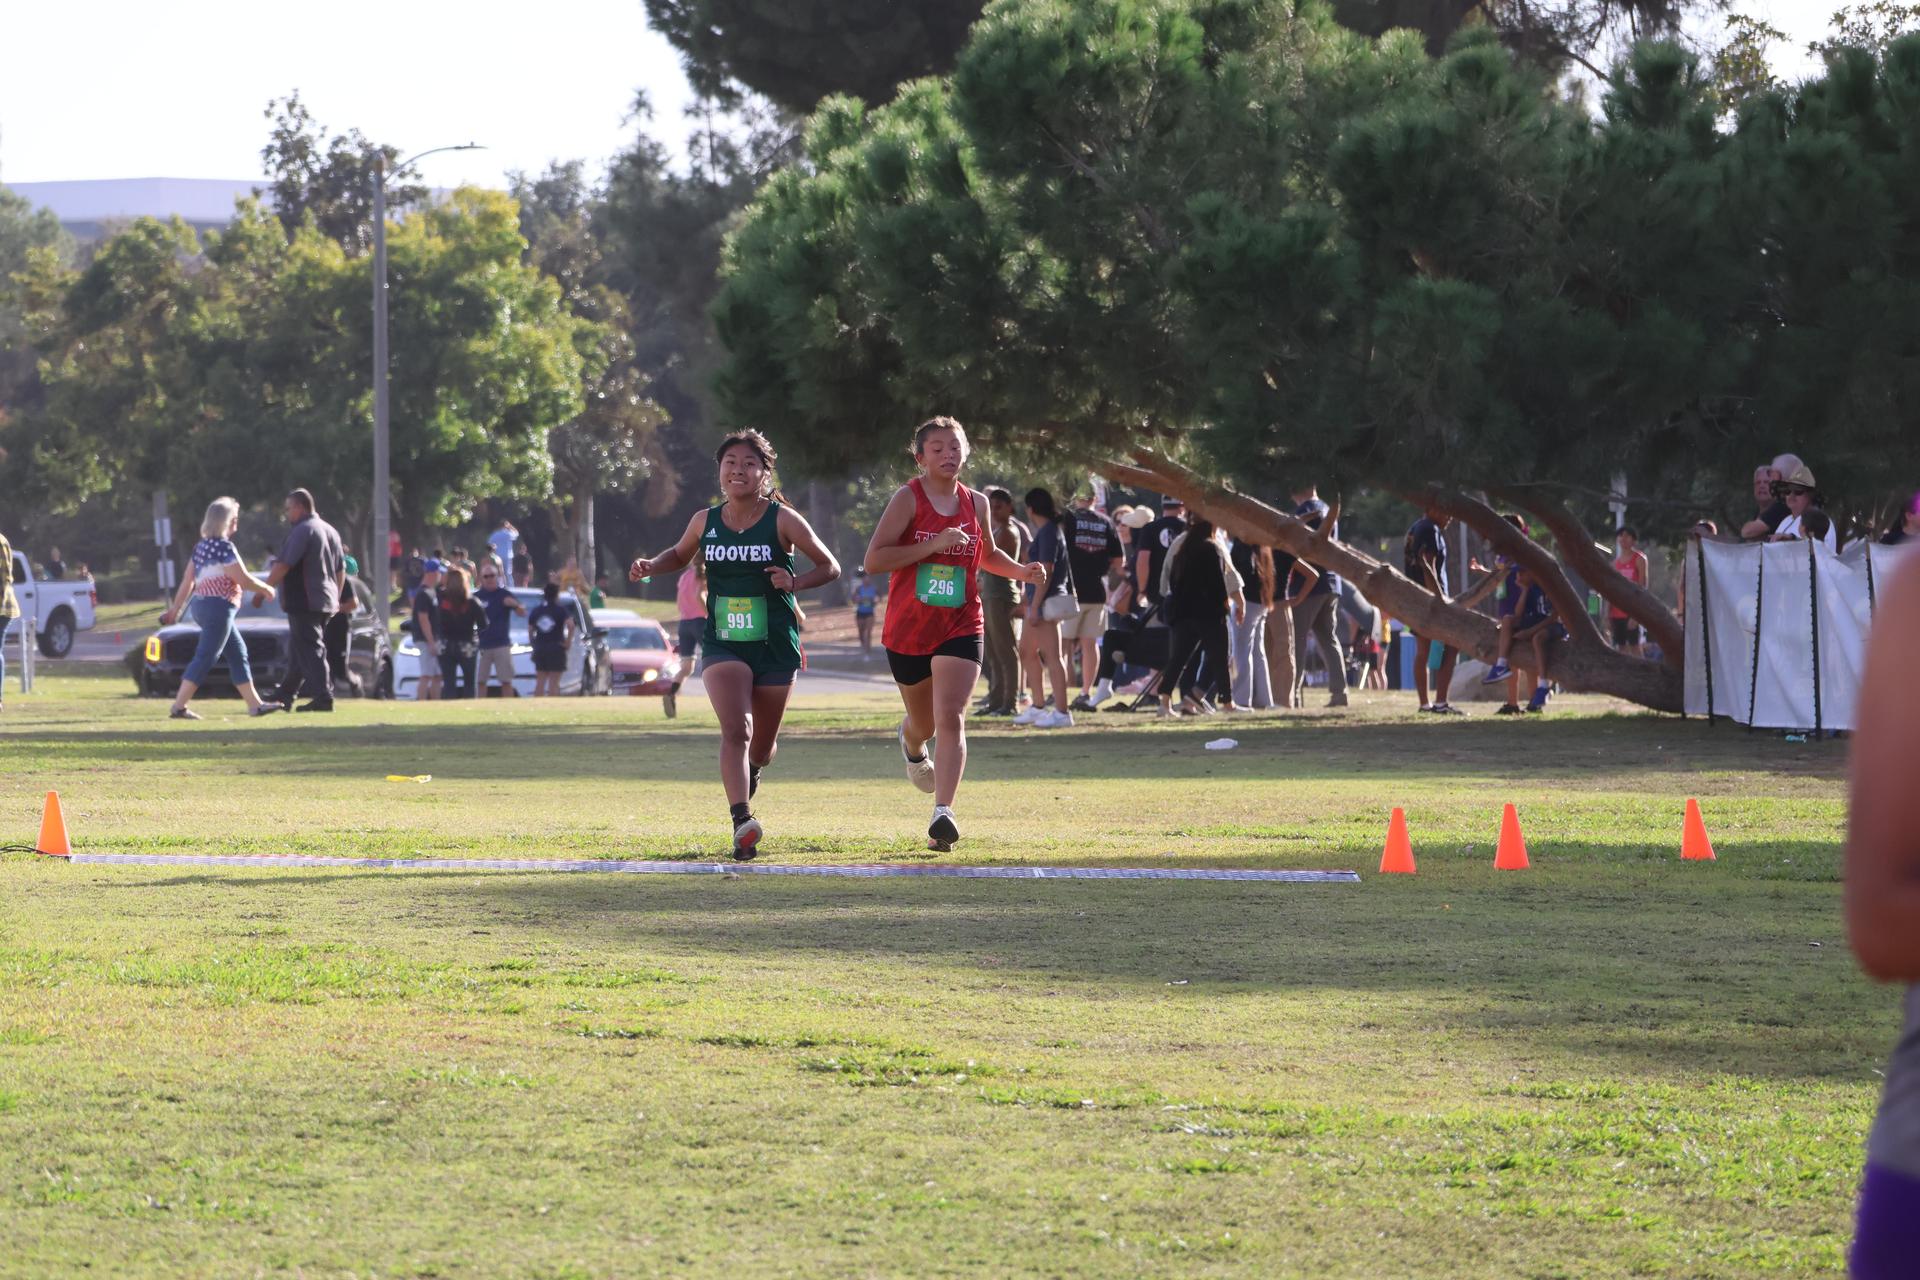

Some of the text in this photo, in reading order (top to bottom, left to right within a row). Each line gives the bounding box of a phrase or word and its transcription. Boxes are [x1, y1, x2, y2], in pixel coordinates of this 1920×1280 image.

[915, 531, 978, 555] TBE
[705, 545, 772, 561] HOOVER
[928, 579, 954, 596] 296
[727, 613, 754, 629] 991
